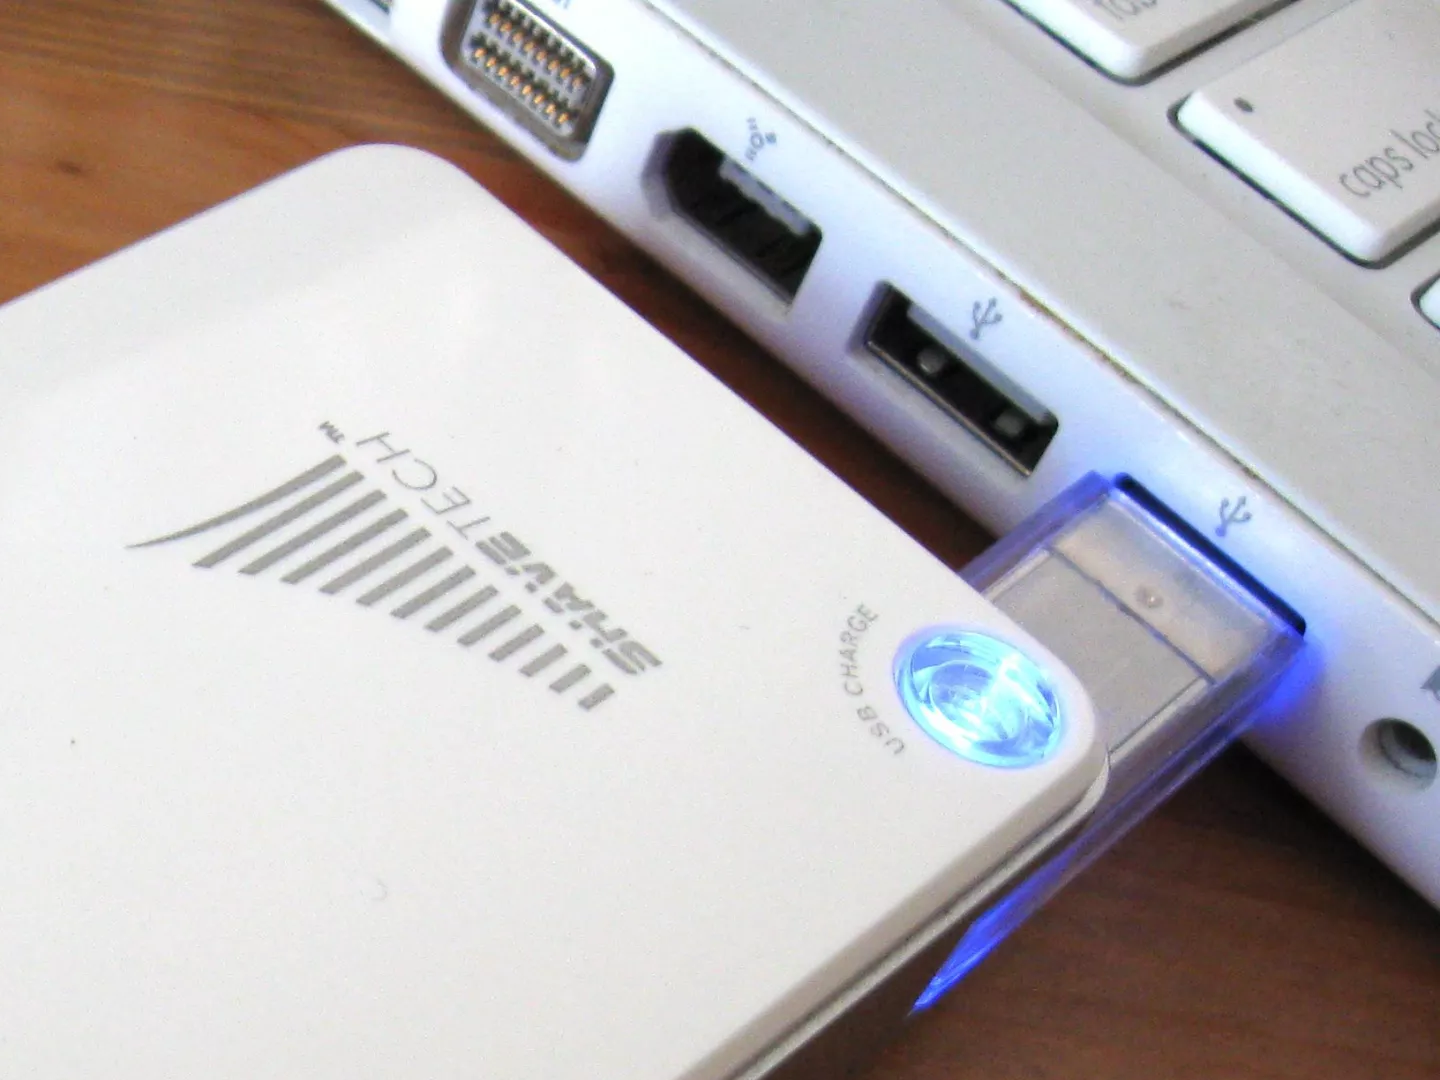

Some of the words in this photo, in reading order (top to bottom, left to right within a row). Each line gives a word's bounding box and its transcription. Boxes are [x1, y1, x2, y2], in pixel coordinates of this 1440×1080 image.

[1339, 146, 1414, 198] caps
[1388, 108, 1440, 160] loc
[356, 431, 664, 675] SHAVETECH
[839, 603, 879, 696] CHARGE
[857, 705, 906, 755] USB
